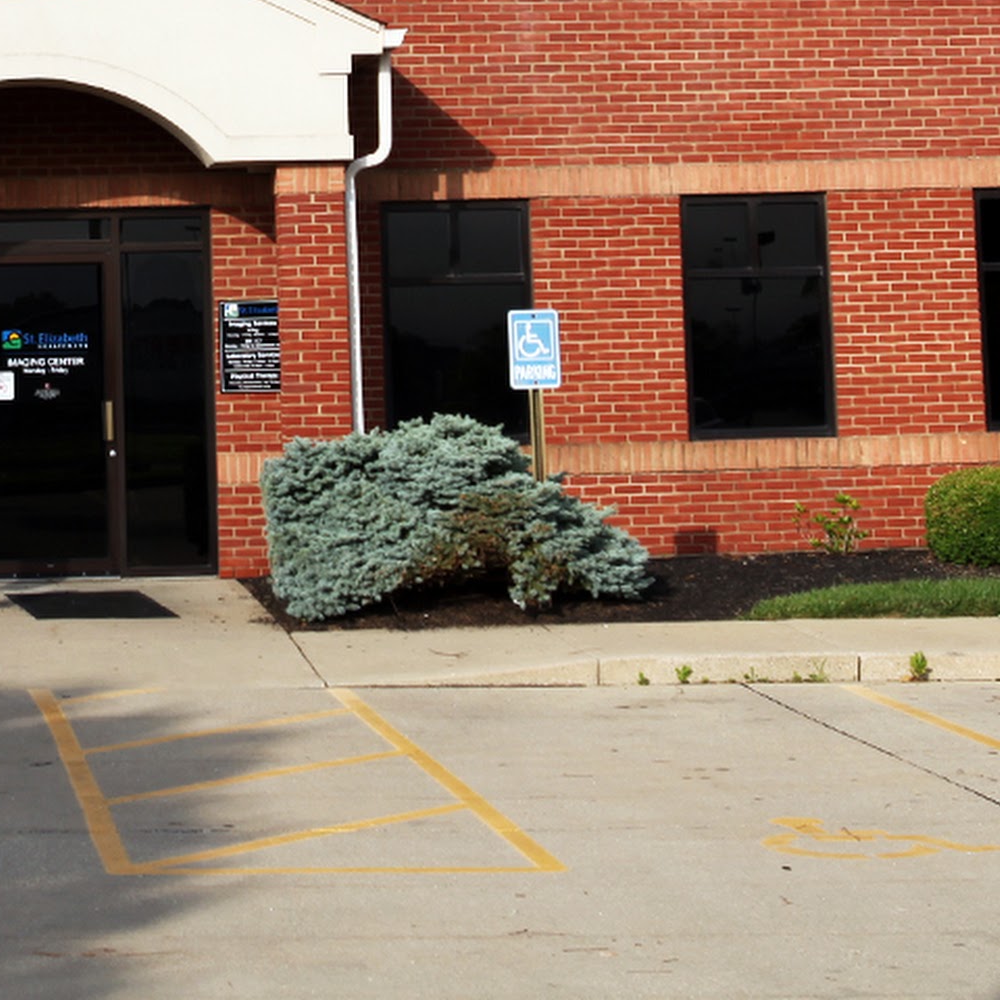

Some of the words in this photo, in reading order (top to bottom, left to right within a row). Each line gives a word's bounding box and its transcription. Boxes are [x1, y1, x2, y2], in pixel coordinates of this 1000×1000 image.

[38, 332, 88, 344] Elizabeth
[7, 357, 46, 368] IMAGING
[47, 356, 85, 367] CENTER
[514, 364, 556, 380] PARKING
